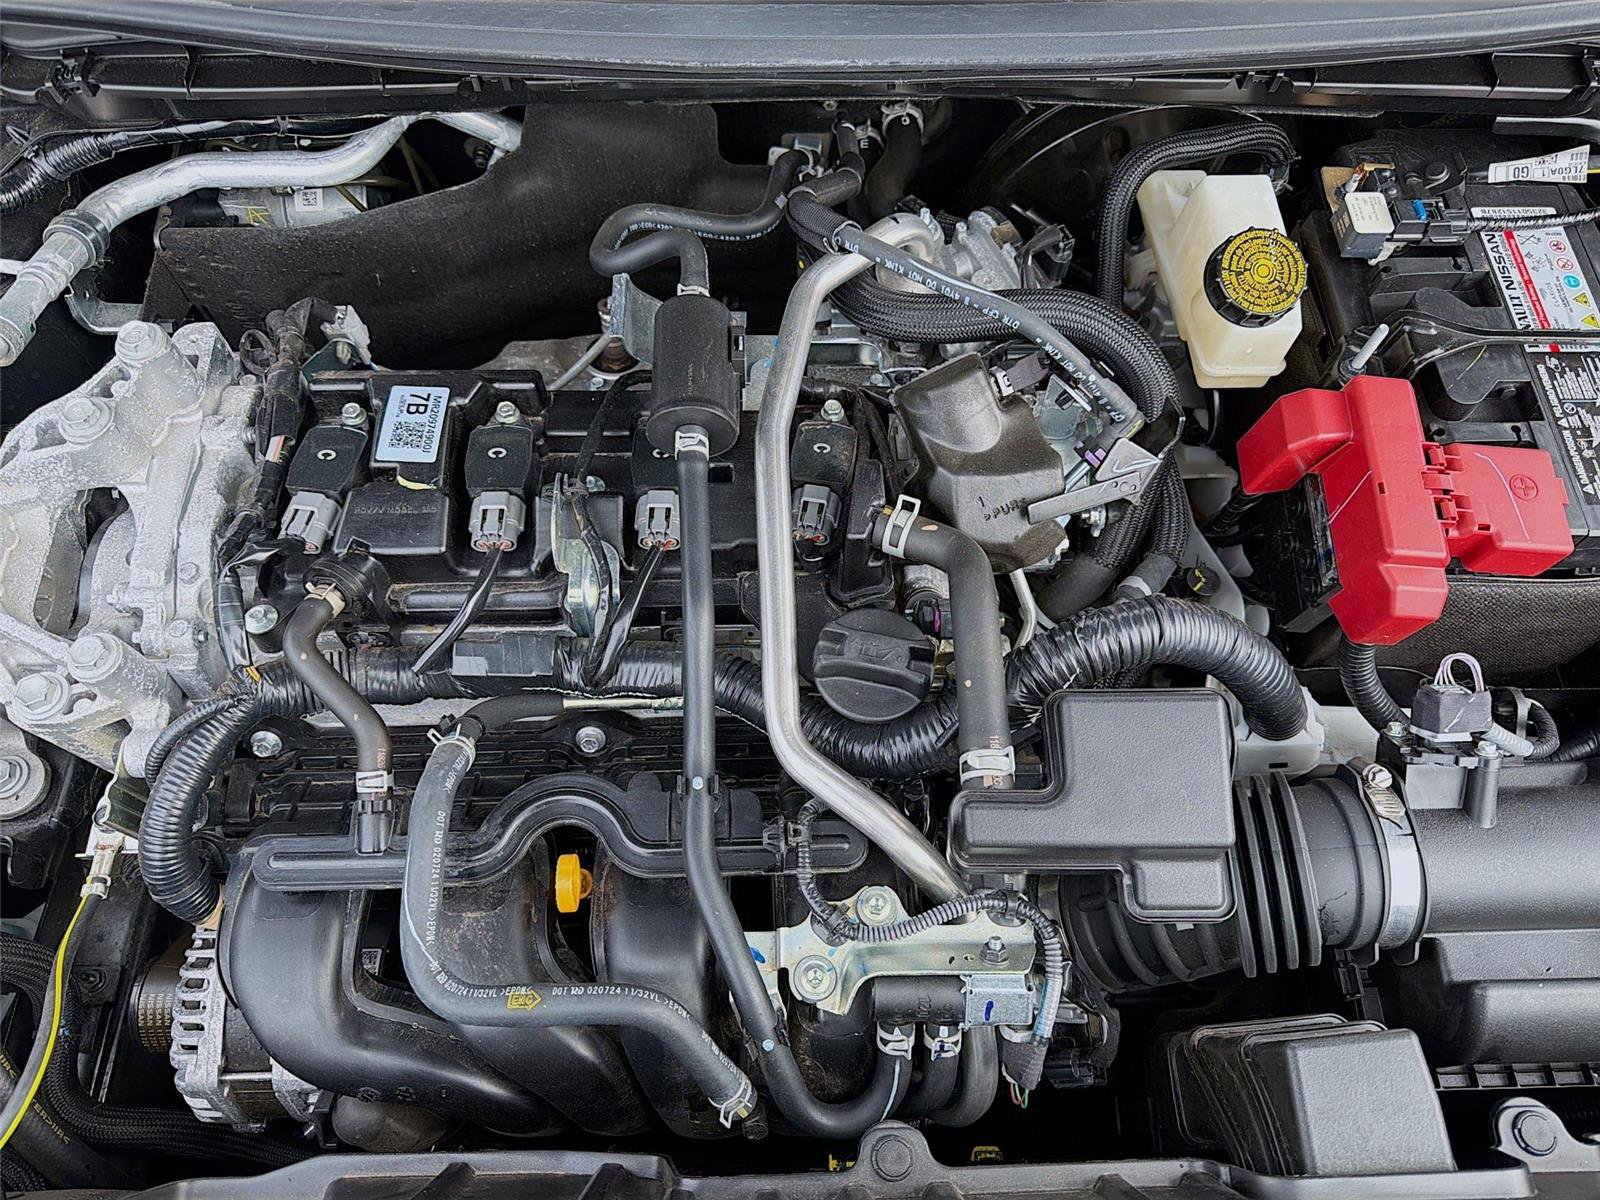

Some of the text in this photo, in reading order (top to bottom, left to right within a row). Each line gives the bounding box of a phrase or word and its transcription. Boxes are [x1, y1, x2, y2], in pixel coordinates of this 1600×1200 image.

[884, 258, 905, 274] KINK
[1485, 233, 1517, 291] NISSAN
[908, 271, 923, 284] NOT
[1043, 342, 1063, 360] KINK
[407, 393, 431, 415] 7B
[1562, 430, 1590, 485] DANGER/POISON
[434, 810, 446, 828] DOT
[431, 847, 442, 878] 020724
[444, 979, 469, 997] 020724
[552, 986, 568, 996] DOT
[587, 986, 621, 995] 020724
[138, 993, 146, 1026] NISSAN
[146, 993, 155, 1026] NISSAN
[155, 993, 164, 1026] NISSAN
[164, 993, 172, 1026] NISSAN
[513, 994, 534, 1005] ENG
